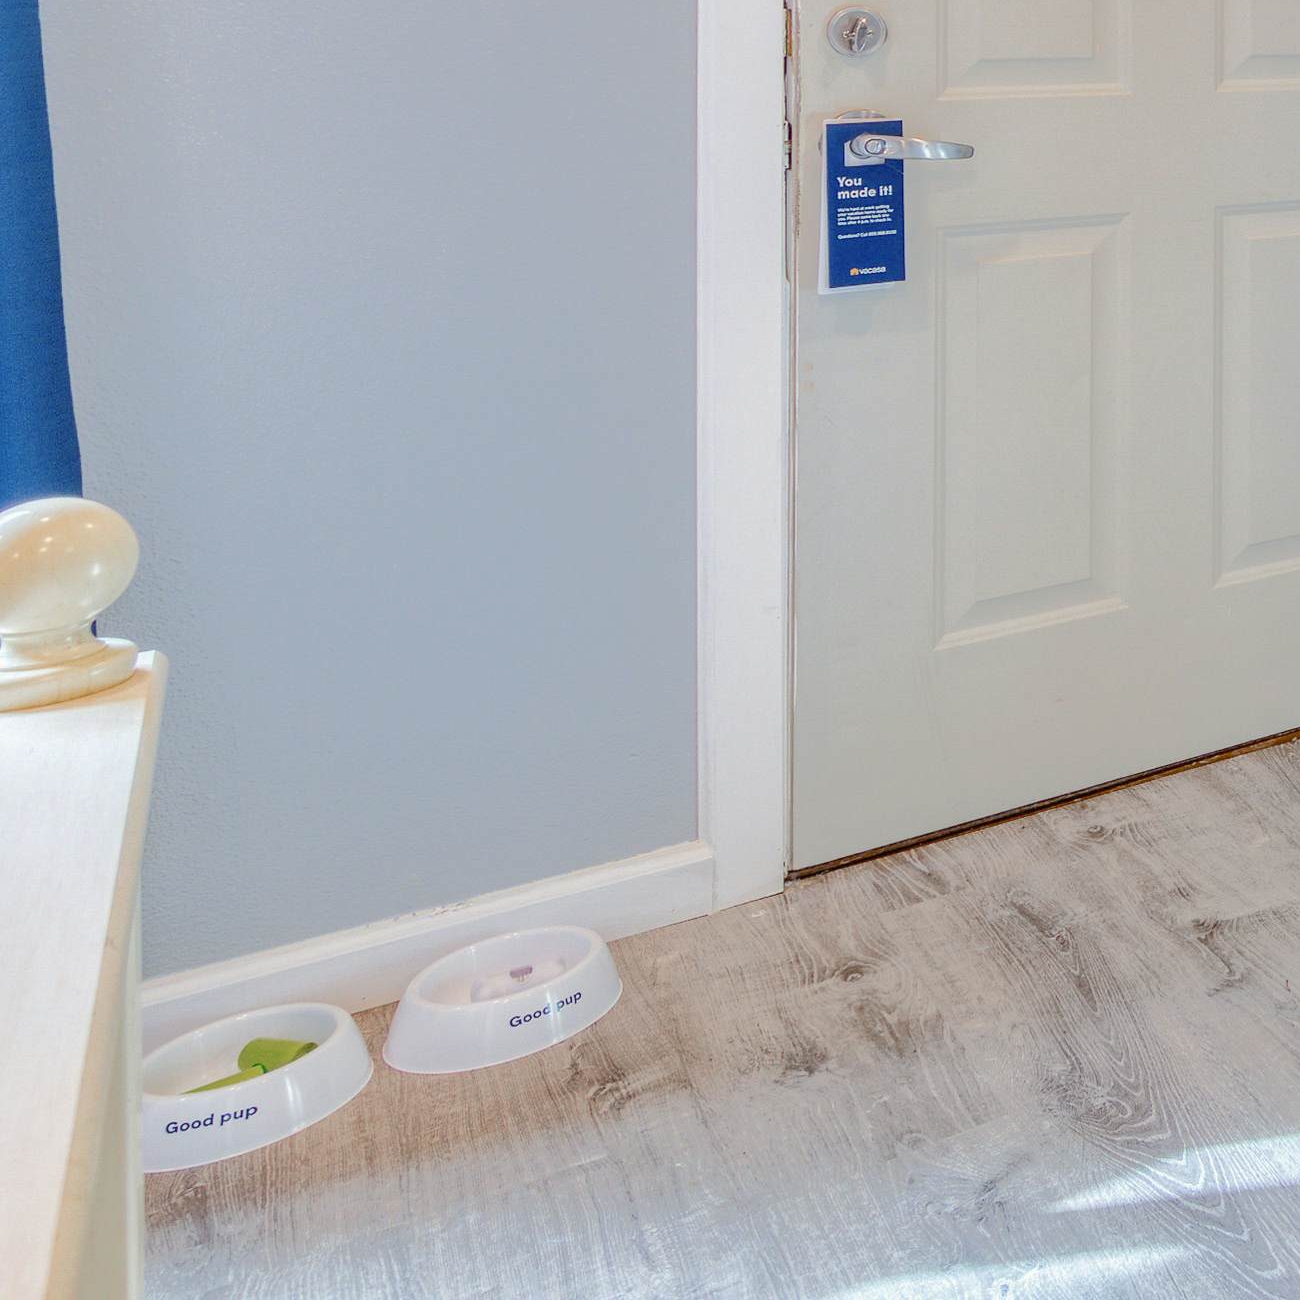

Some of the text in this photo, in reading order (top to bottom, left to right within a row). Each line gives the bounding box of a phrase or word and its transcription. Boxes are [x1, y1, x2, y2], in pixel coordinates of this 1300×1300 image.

[837, 176, 863, 187] You
[837, 185, 893, 200] made it!
[508, 989, 583, 1029] Good pup
[165, 1104, 259, 1135] Good pup
